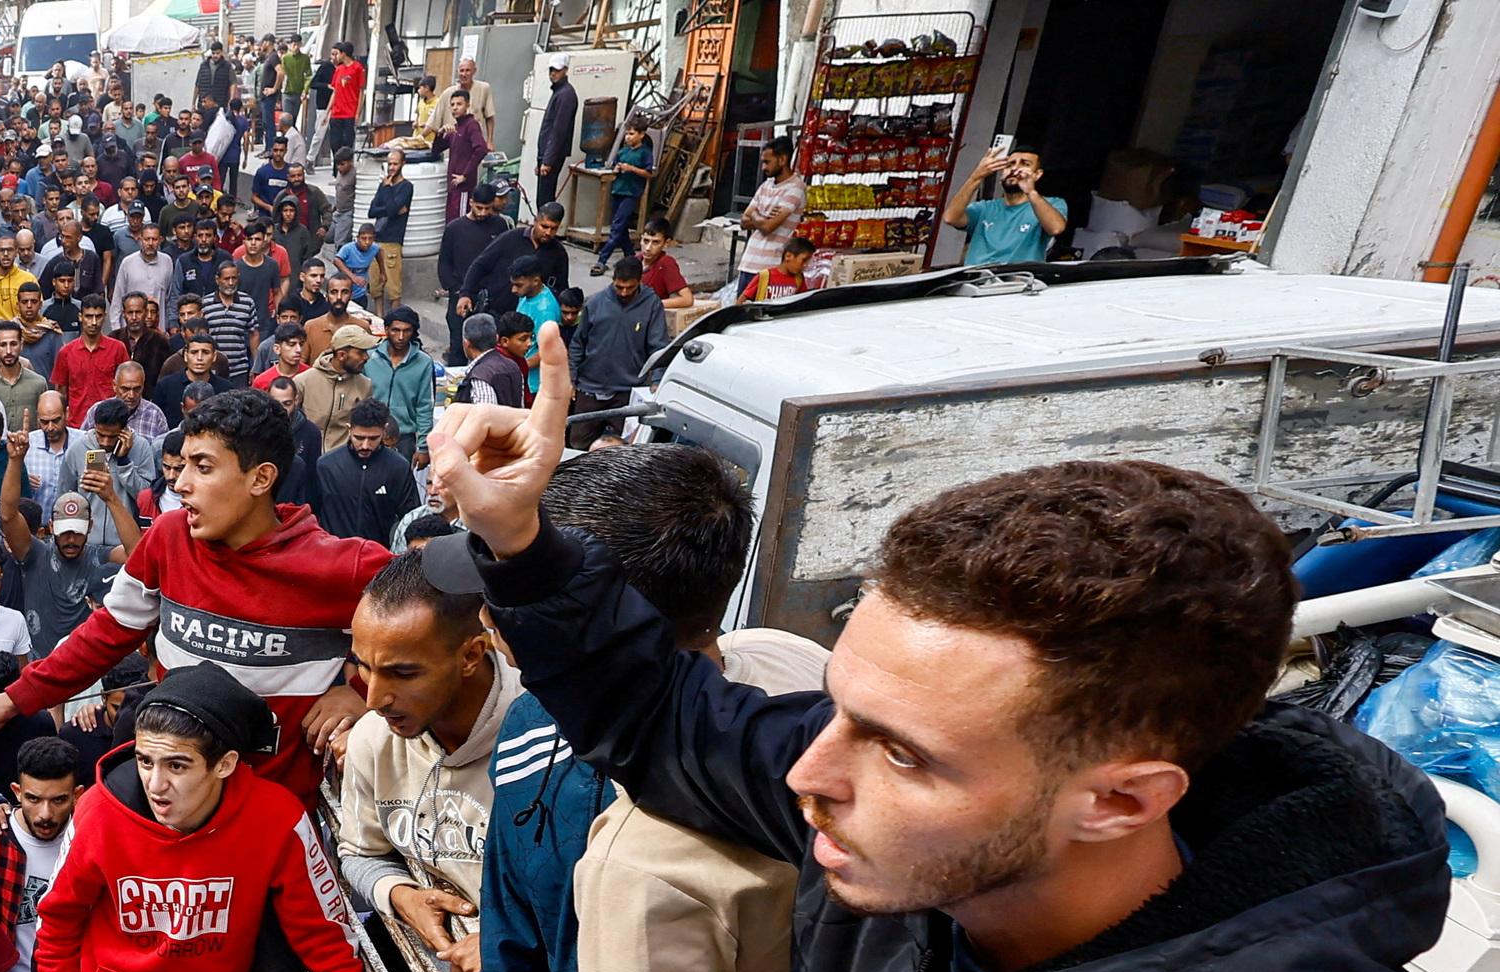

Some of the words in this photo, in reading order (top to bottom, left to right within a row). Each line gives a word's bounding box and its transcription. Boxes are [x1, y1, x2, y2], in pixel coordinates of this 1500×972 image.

[170, 611, 292, 657] RACING
[191, 641, 204, 650] ON
[205, 644, 248, 658] STREETS
[121, 879, 230, 935] SPORT
